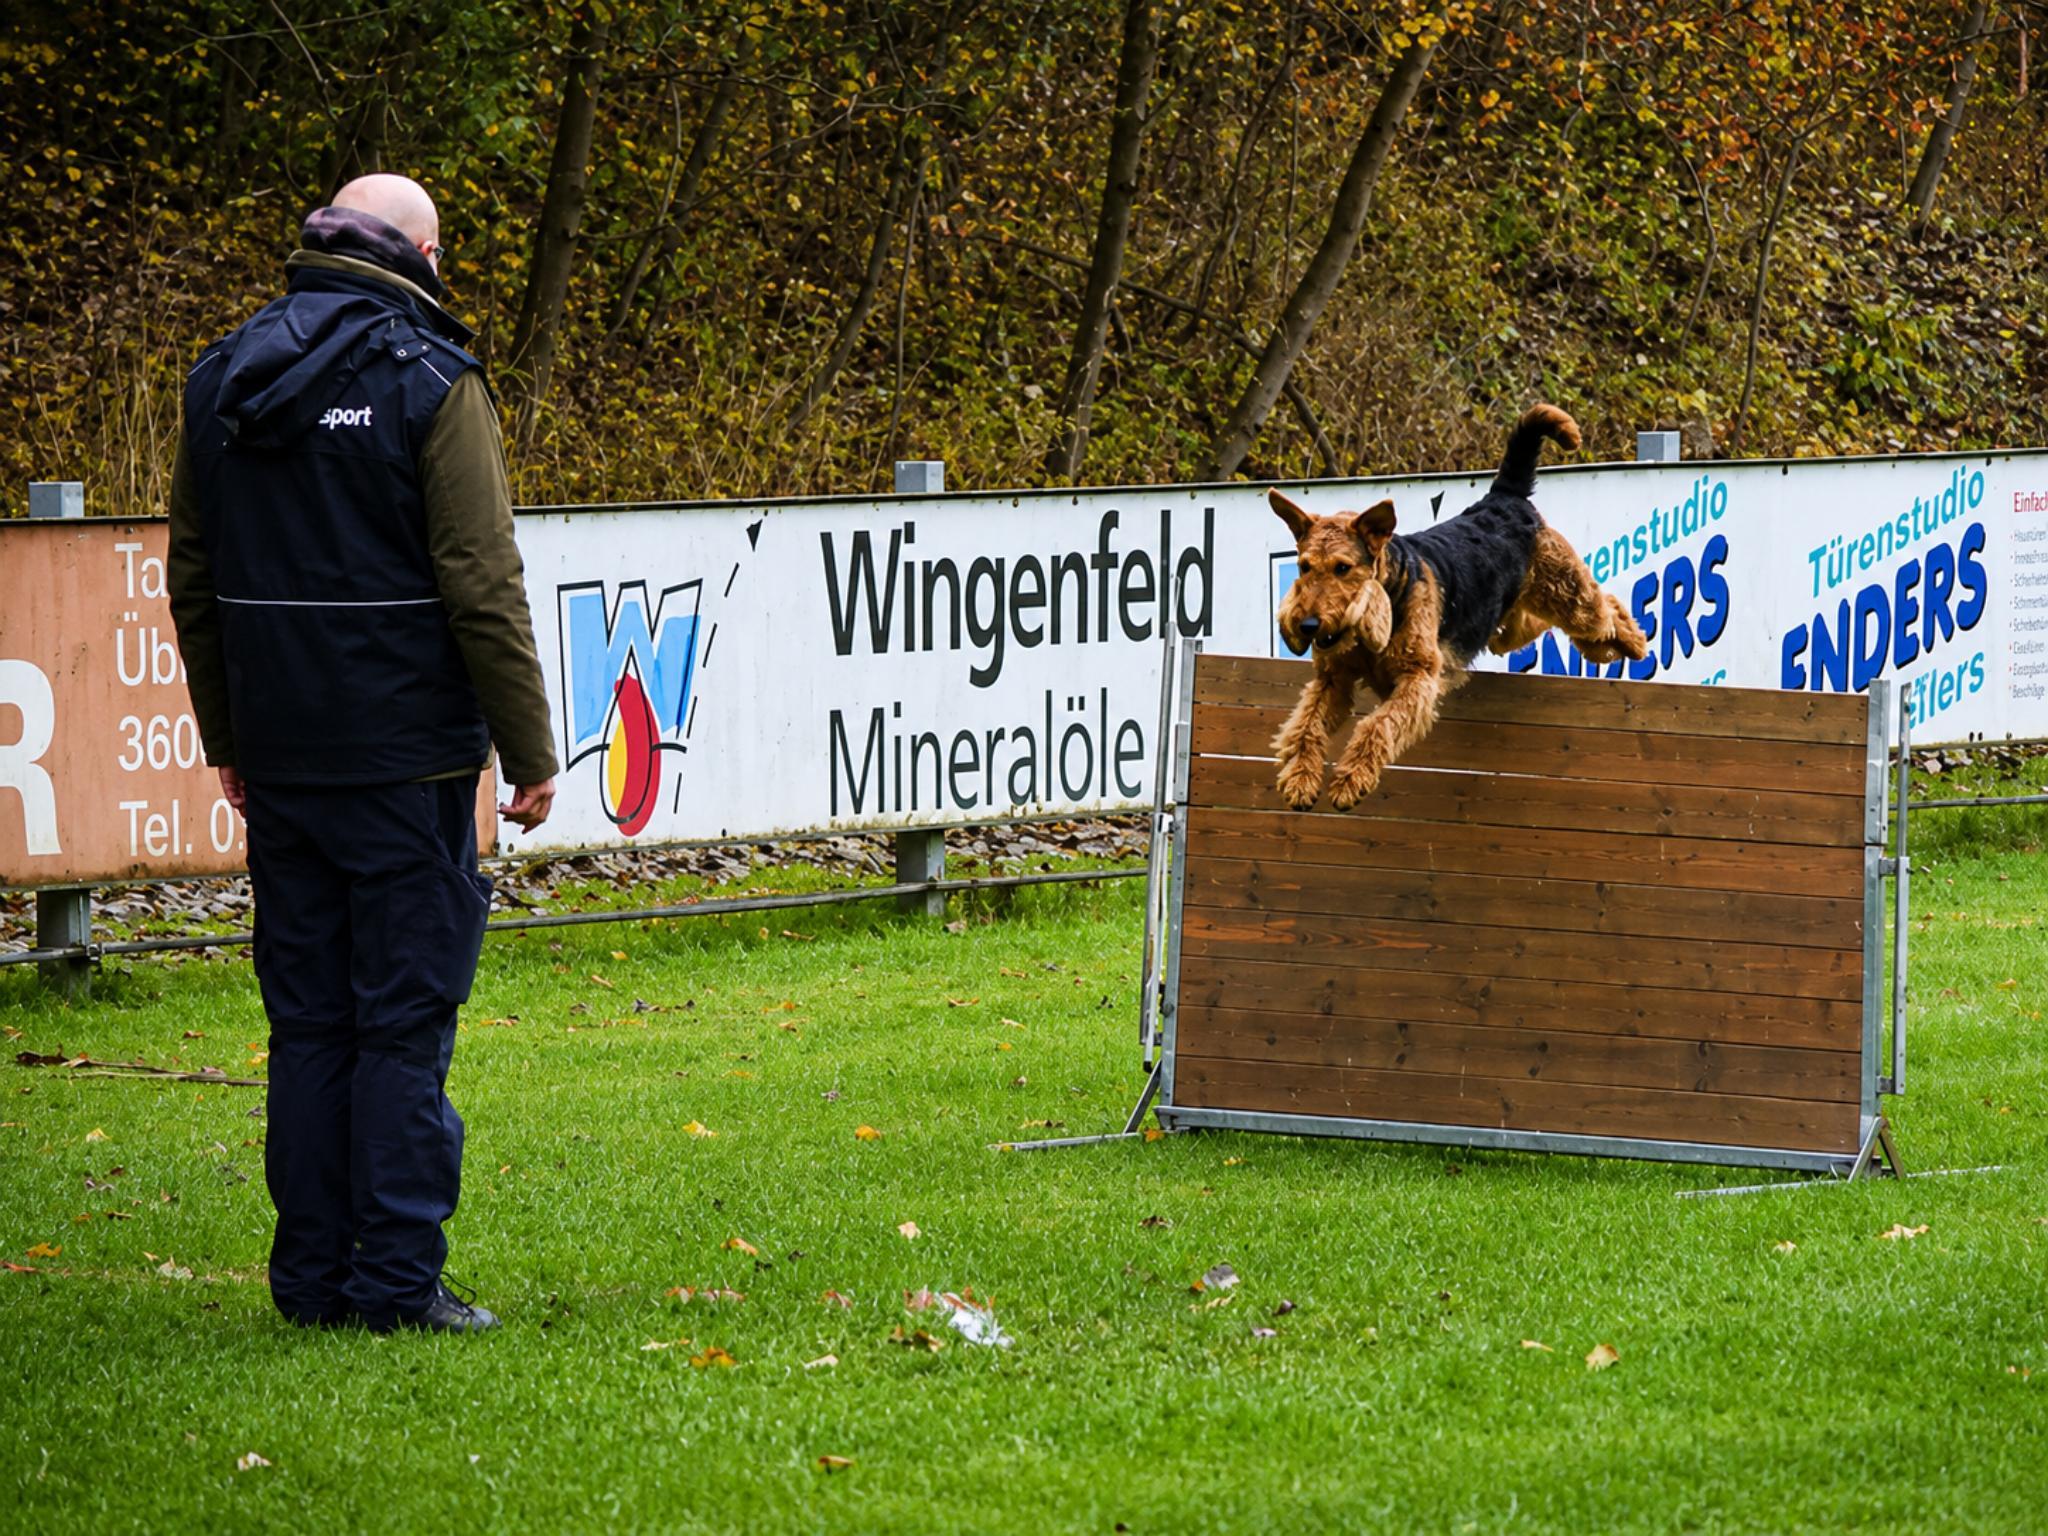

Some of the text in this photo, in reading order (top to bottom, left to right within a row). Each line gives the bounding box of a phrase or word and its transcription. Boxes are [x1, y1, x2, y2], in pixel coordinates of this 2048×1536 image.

[1808, 464, 1985, 598] Türenstudio
[115, 611, 187, 686] Üb
[820, 507, 1215, 688] Wingenfeld
[1781, 522, 1987, 694] ENDERS
[118, 713, 207, 772] 360
[829, 687, 1145, 817] Mineralöle
[119, 798, 193, 857] Tel.
